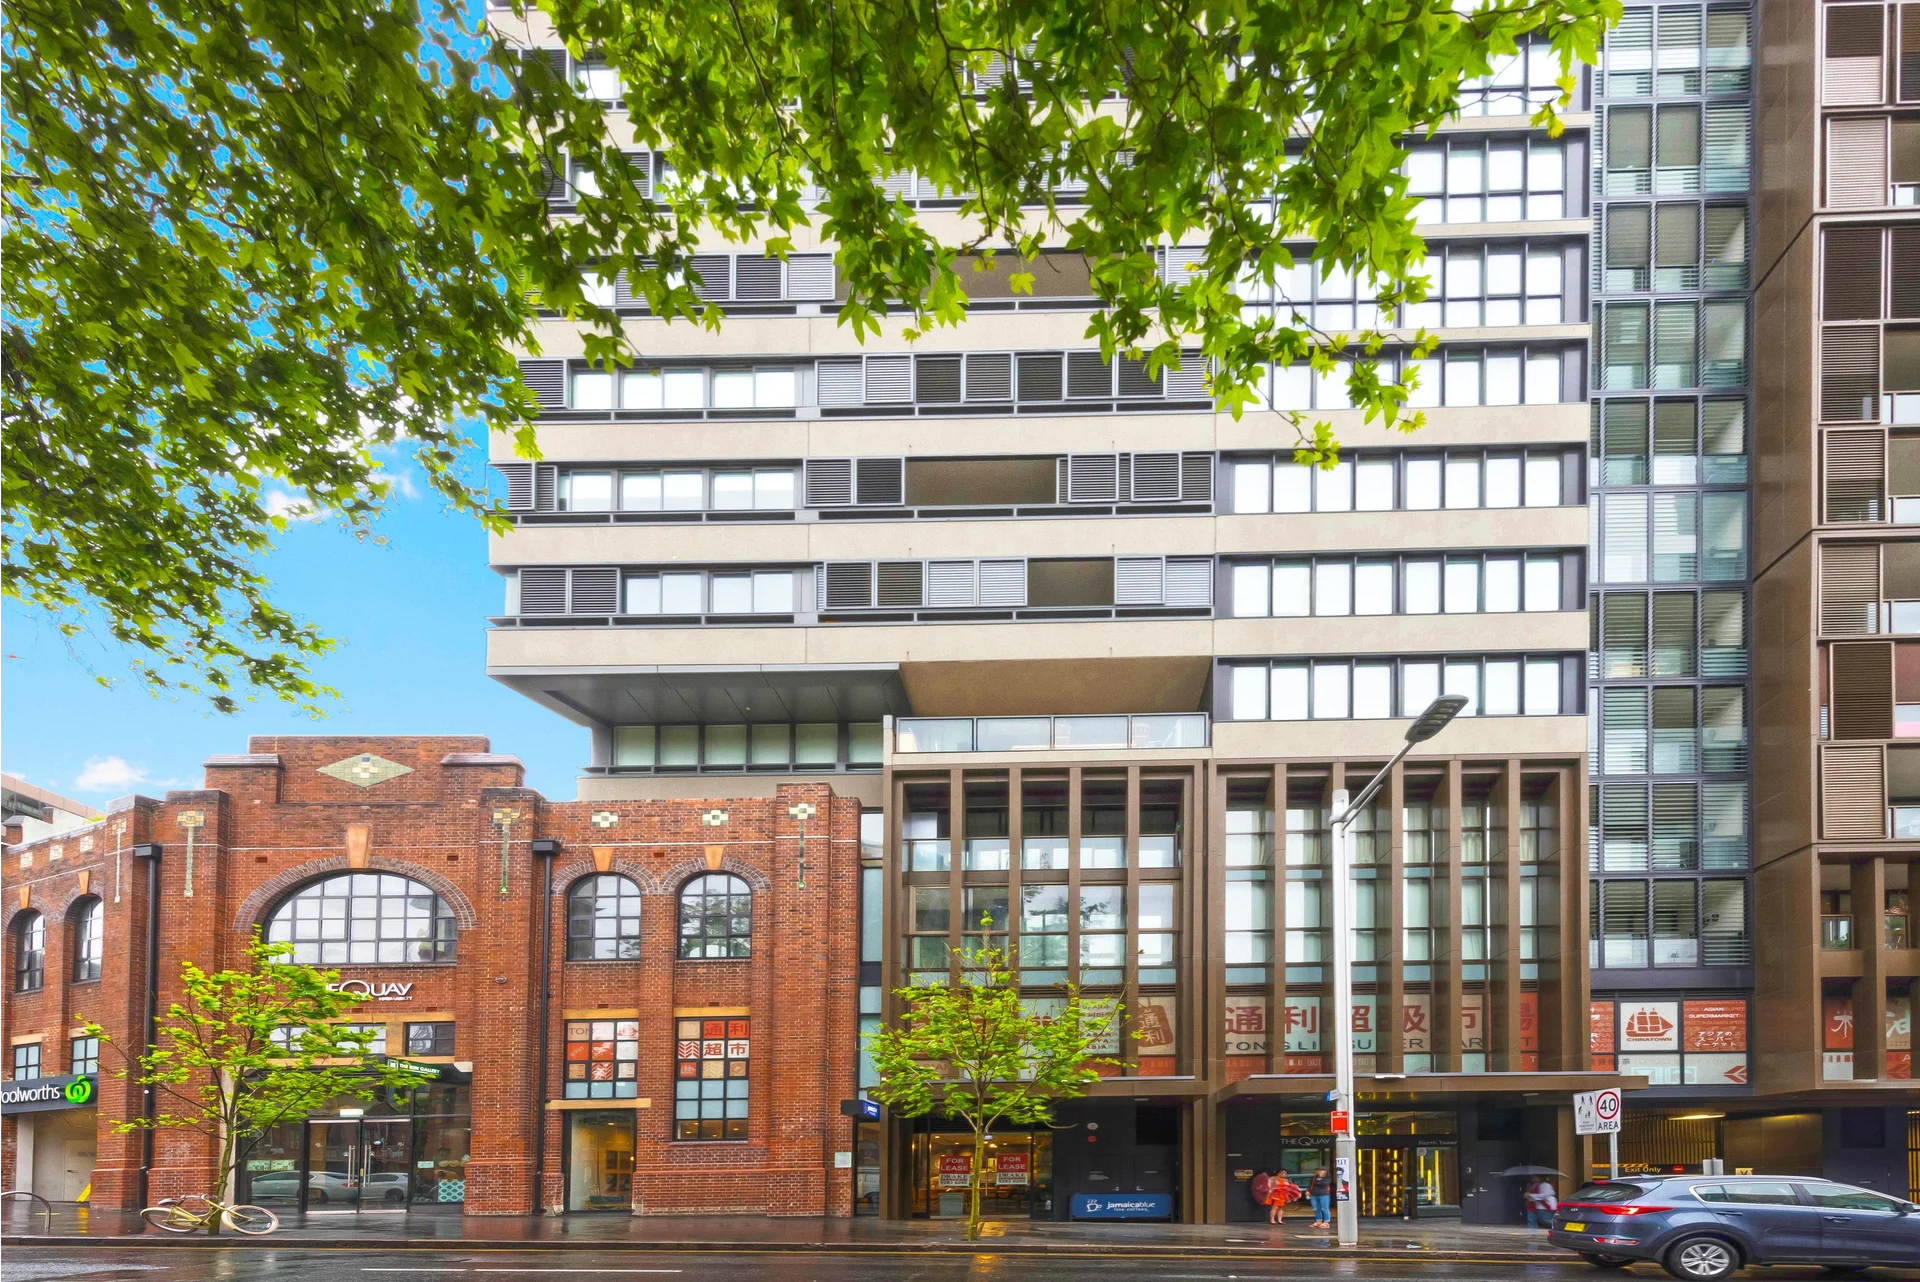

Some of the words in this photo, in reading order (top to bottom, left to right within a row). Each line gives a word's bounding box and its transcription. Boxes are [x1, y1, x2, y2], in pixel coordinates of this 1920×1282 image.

[703, 1042, 748, 1056] 超市
[1, 1083, 60, 1104] oolworths
[1600, 1098, 1617, 1112] 40
[1597, 1121, 1619, 1131] AREA
[1298, 1136, 1331, 1146] QUAY
